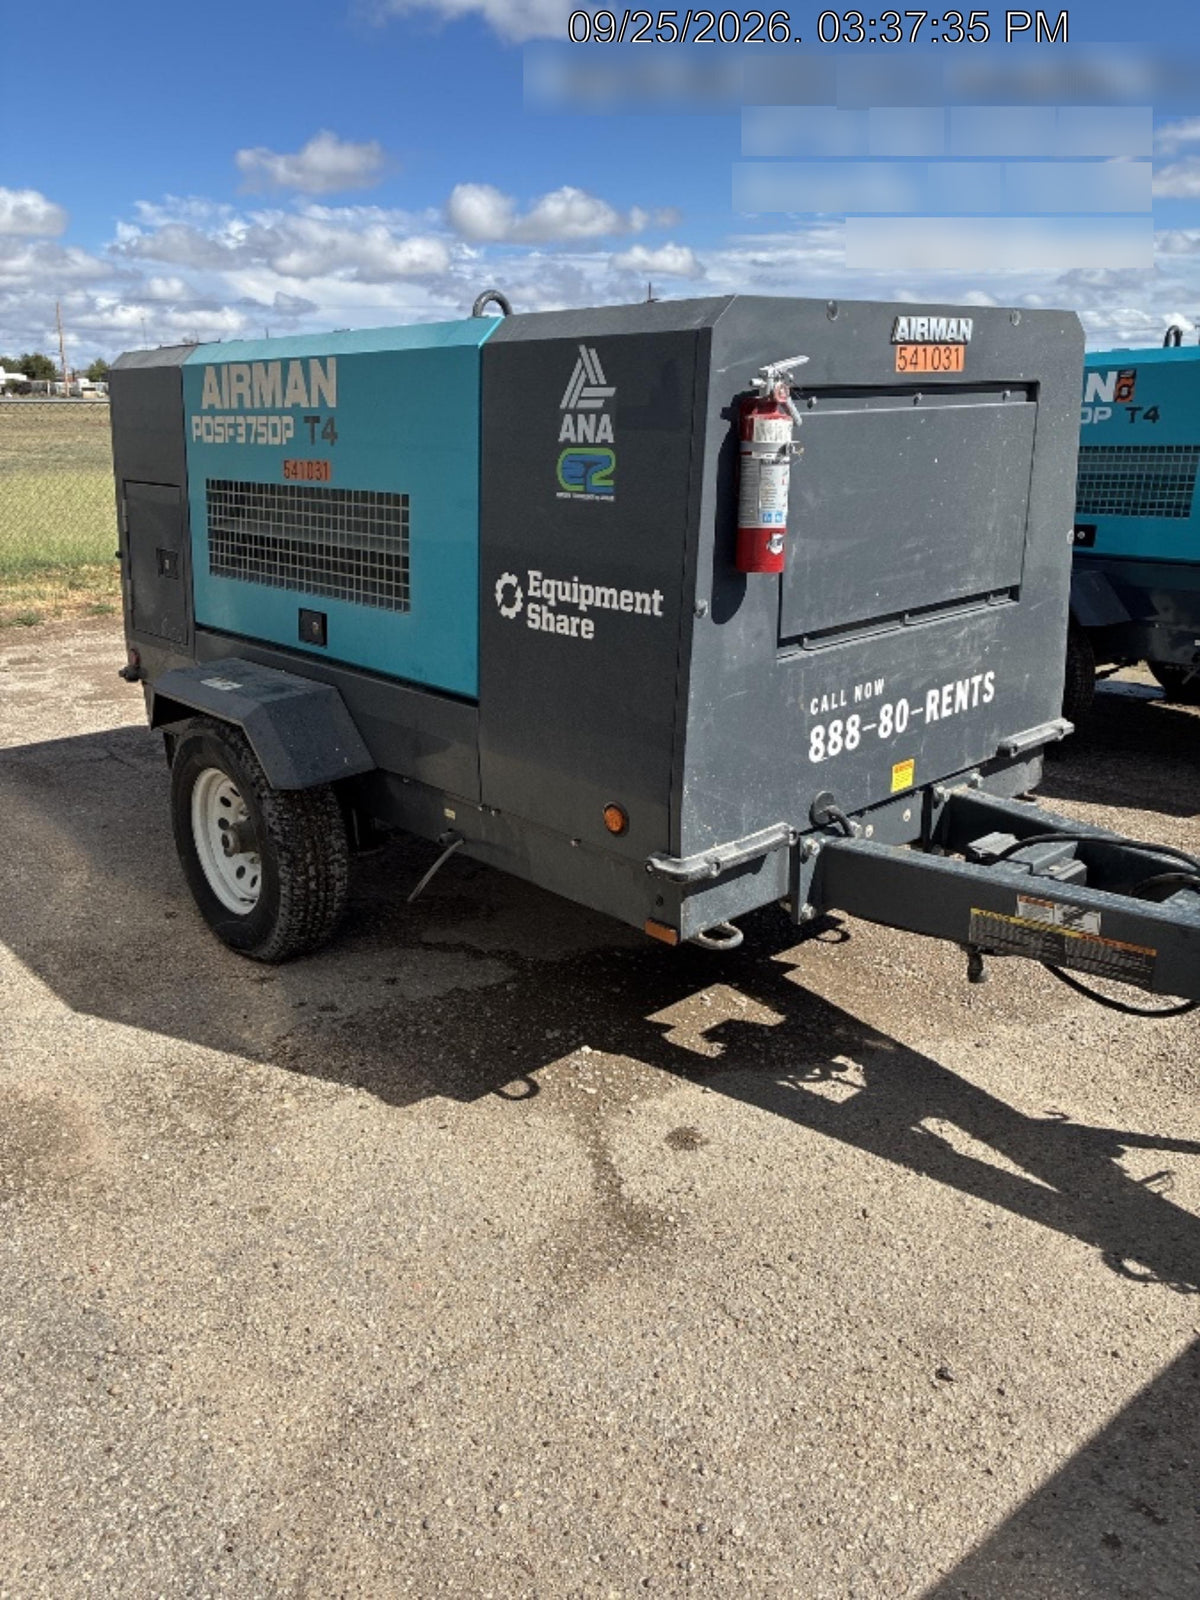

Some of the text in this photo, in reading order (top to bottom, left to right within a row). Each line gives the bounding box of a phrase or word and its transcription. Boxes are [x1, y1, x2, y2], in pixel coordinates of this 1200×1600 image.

[895, 316, 972, 342] AIRMAN
[897, 346, 961, 371] 541031
[201, 357, 337, 409] AIRMAN
[558, 414, 615, 443] ANA
[1125, 404, 1160, 424] T4
[304, 416, 338, 446] T4
[283, 460, 330, 481] 541031
[527, 570, 664, 617] Equipment
[526, 603, 595, 640] Share
[810, 678, 885, 715] CALL NOW
[808, 671, 995, 763] 888-80-RENTS
